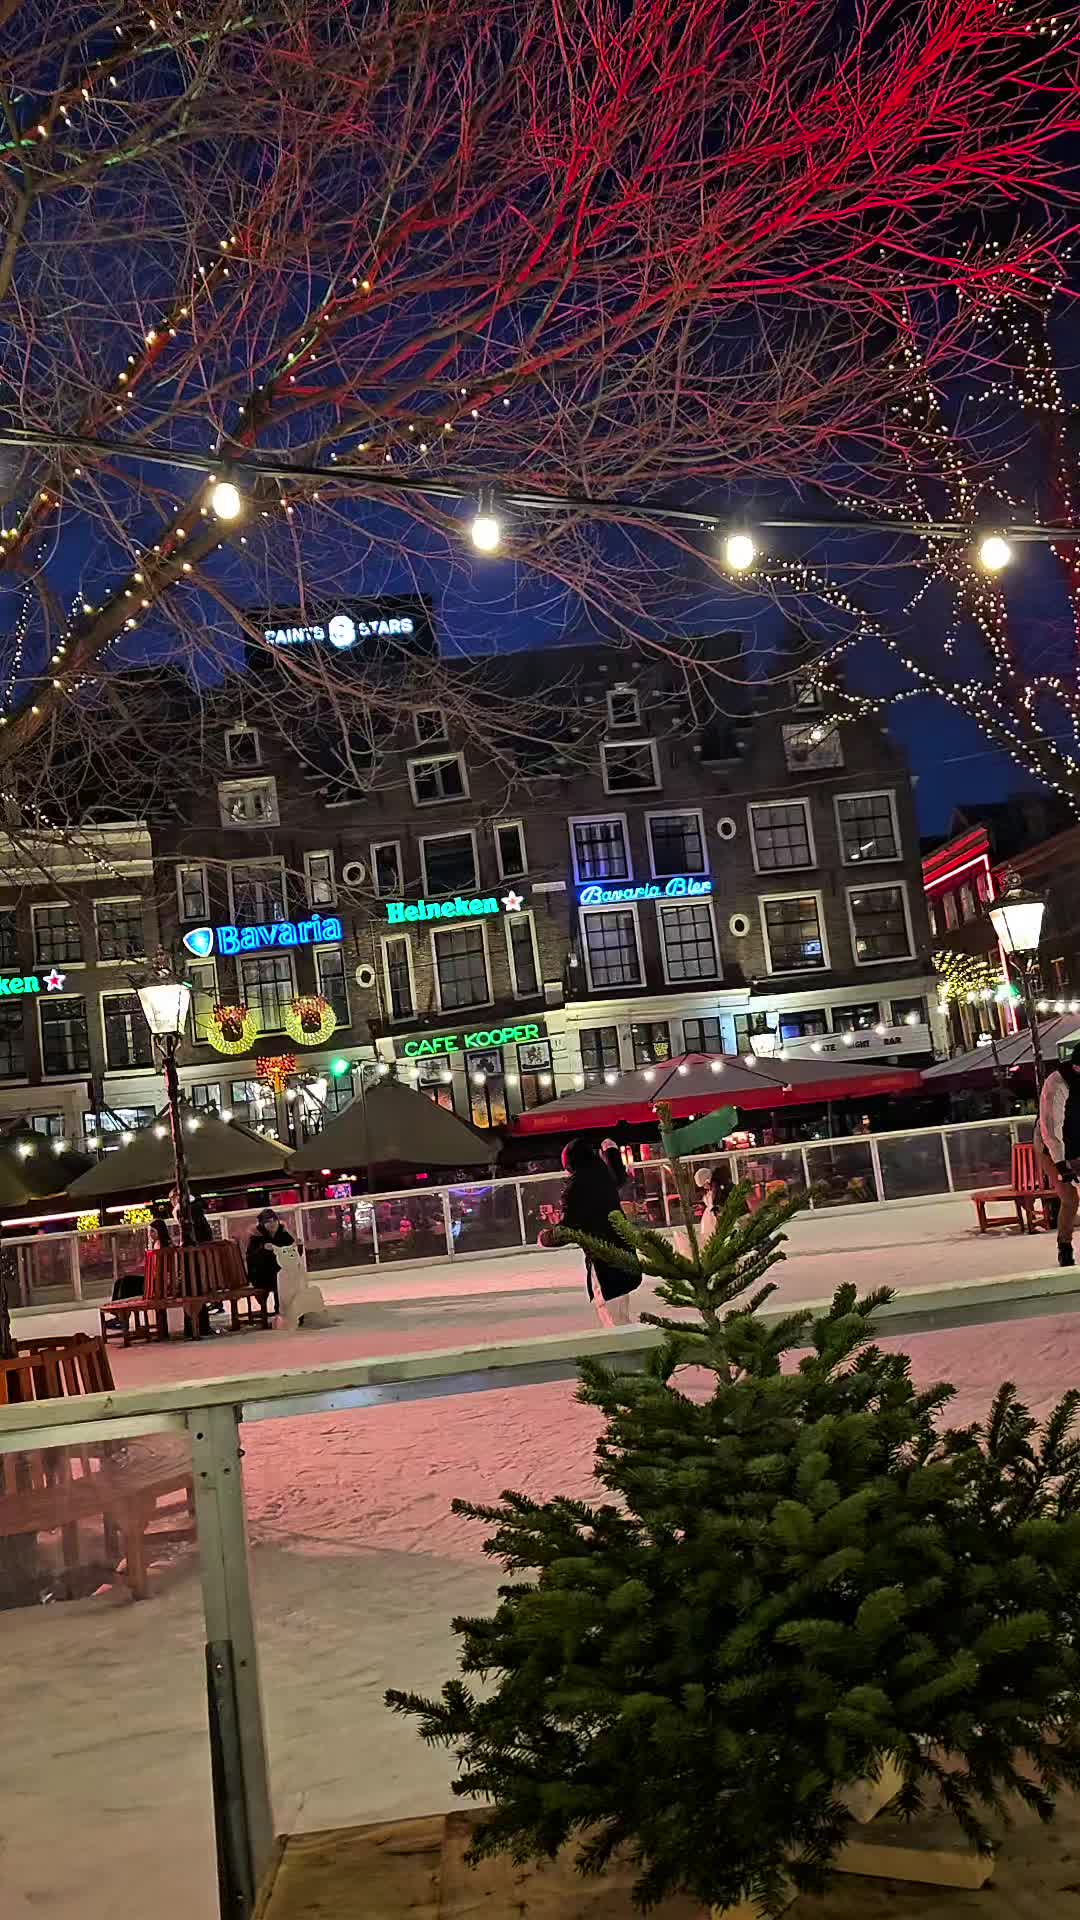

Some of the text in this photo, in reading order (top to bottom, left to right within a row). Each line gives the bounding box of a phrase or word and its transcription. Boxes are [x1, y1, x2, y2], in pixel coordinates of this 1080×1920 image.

[264, 618, 413, 645] SAINTS STARS
[580, 877, 712, 904] Bavaria Bier
[385, 896, 500, 924] Heineken
[216, 913, 342, 955] Bavaria
[404, 1024, 540, 1058] CAFE KOOPER
[883, 1036, 902, 1046] BAR
